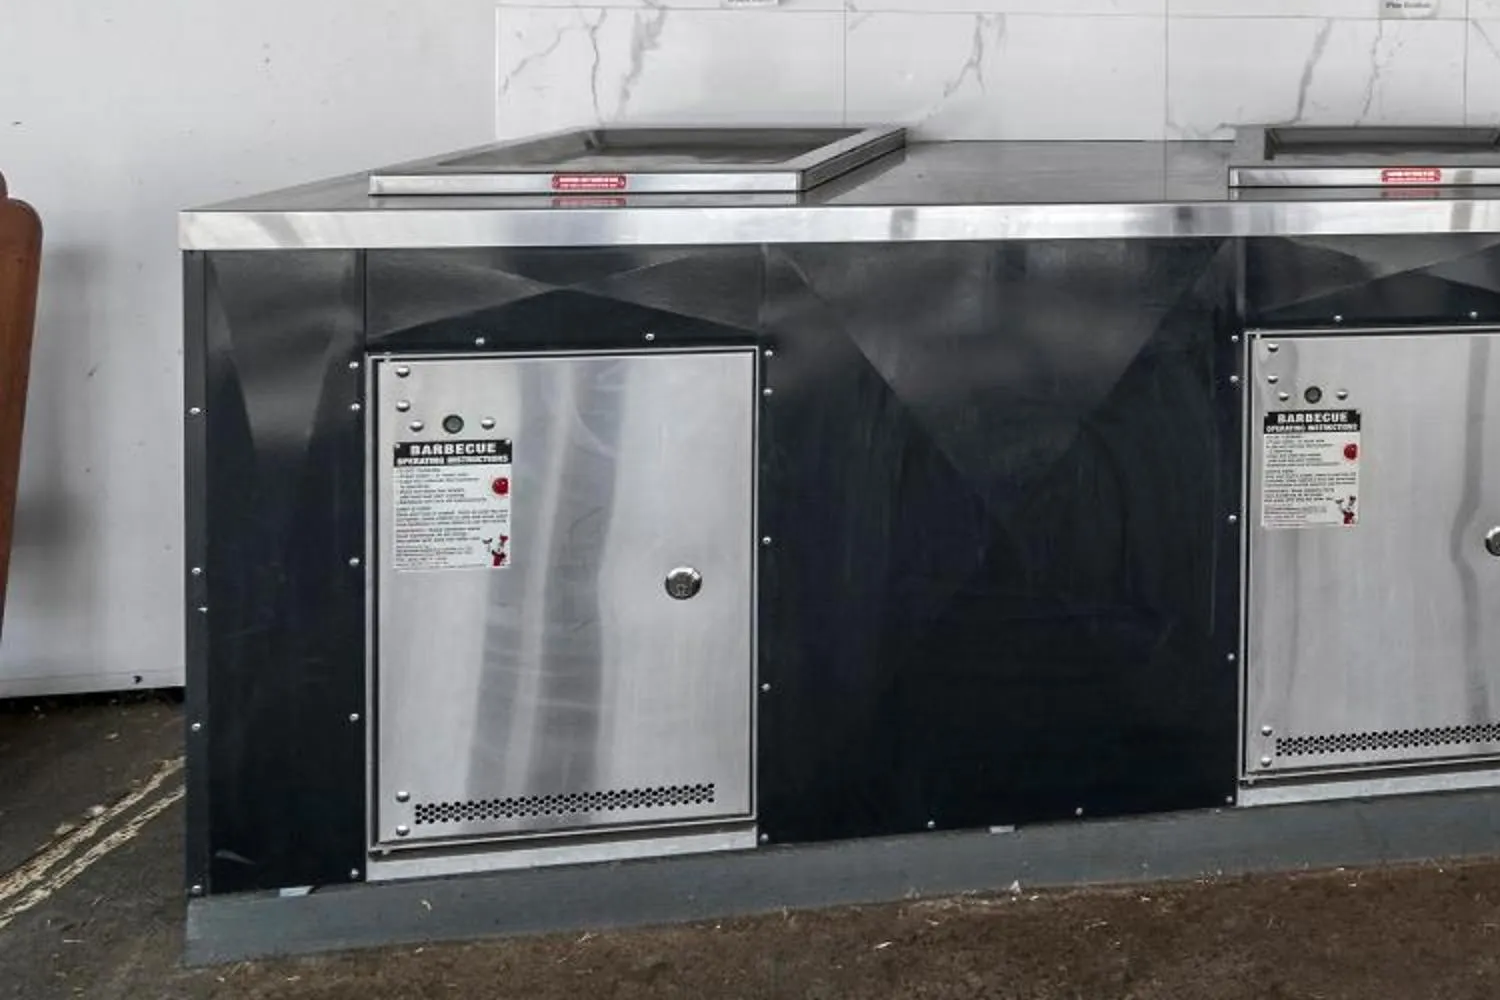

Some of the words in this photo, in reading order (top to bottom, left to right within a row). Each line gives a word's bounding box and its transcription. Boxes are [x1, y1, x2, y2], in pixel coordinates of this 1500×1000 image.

[1277, 412, 1348, 424] BARBECUE
[1265, 425, 1306, 433] OPERATING
[1307, 423, 1359, 431] INSTRUCTIONS
[409, 443, 497, 456] BARBECUE
[396, 456, 445, 466] OPERATING
[446, 455, 509, 464] INSTRUCTIONS
